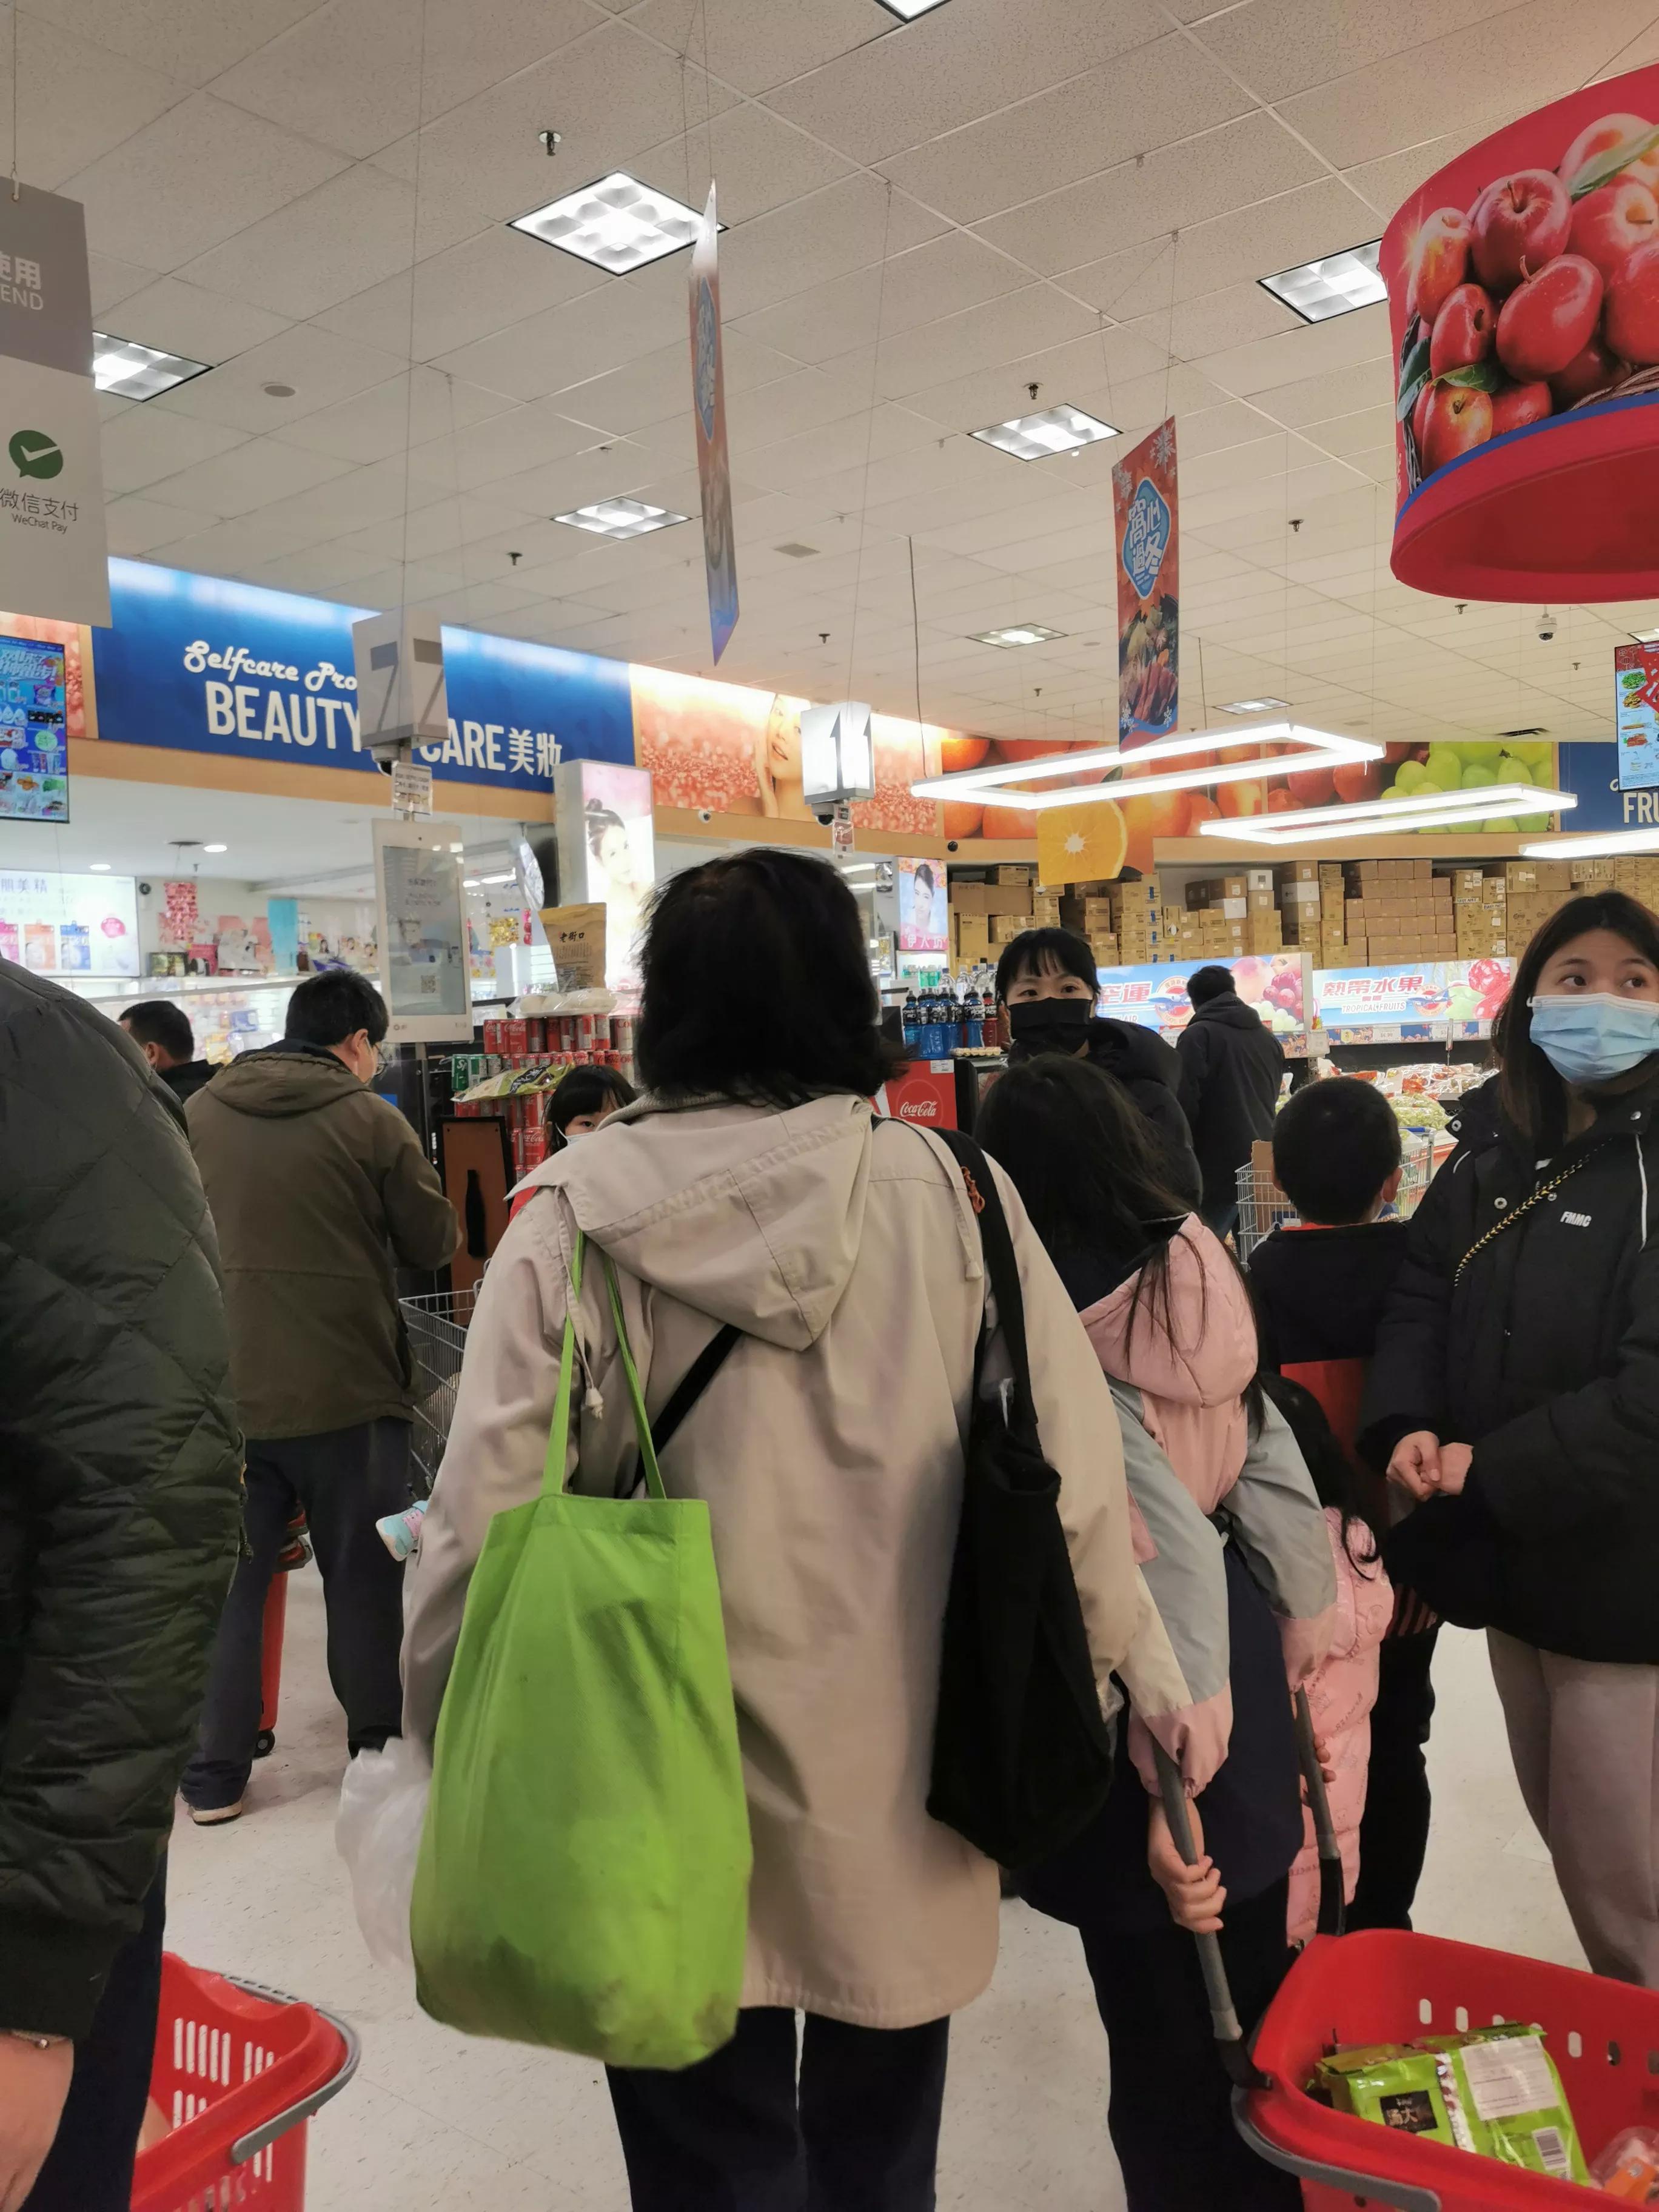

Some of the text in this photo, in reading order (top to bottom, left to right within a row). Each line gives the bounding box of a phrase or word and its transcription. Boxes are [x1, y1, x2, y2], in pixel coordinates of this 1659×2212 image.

[0, 488, 79, 521] 微信支付
[11, 513, 68, 534] WeChat Pay
[184, 640, 300, 682] Selfcare
[205, 680, 362, 752] BEAUTY
[1323, 976, 1423, 996] 熱帶水果
[1342, 1002, 1406, 1013] TROPICAL FRUITS
[900, 1101, 937, 1117] Coca-Cola
